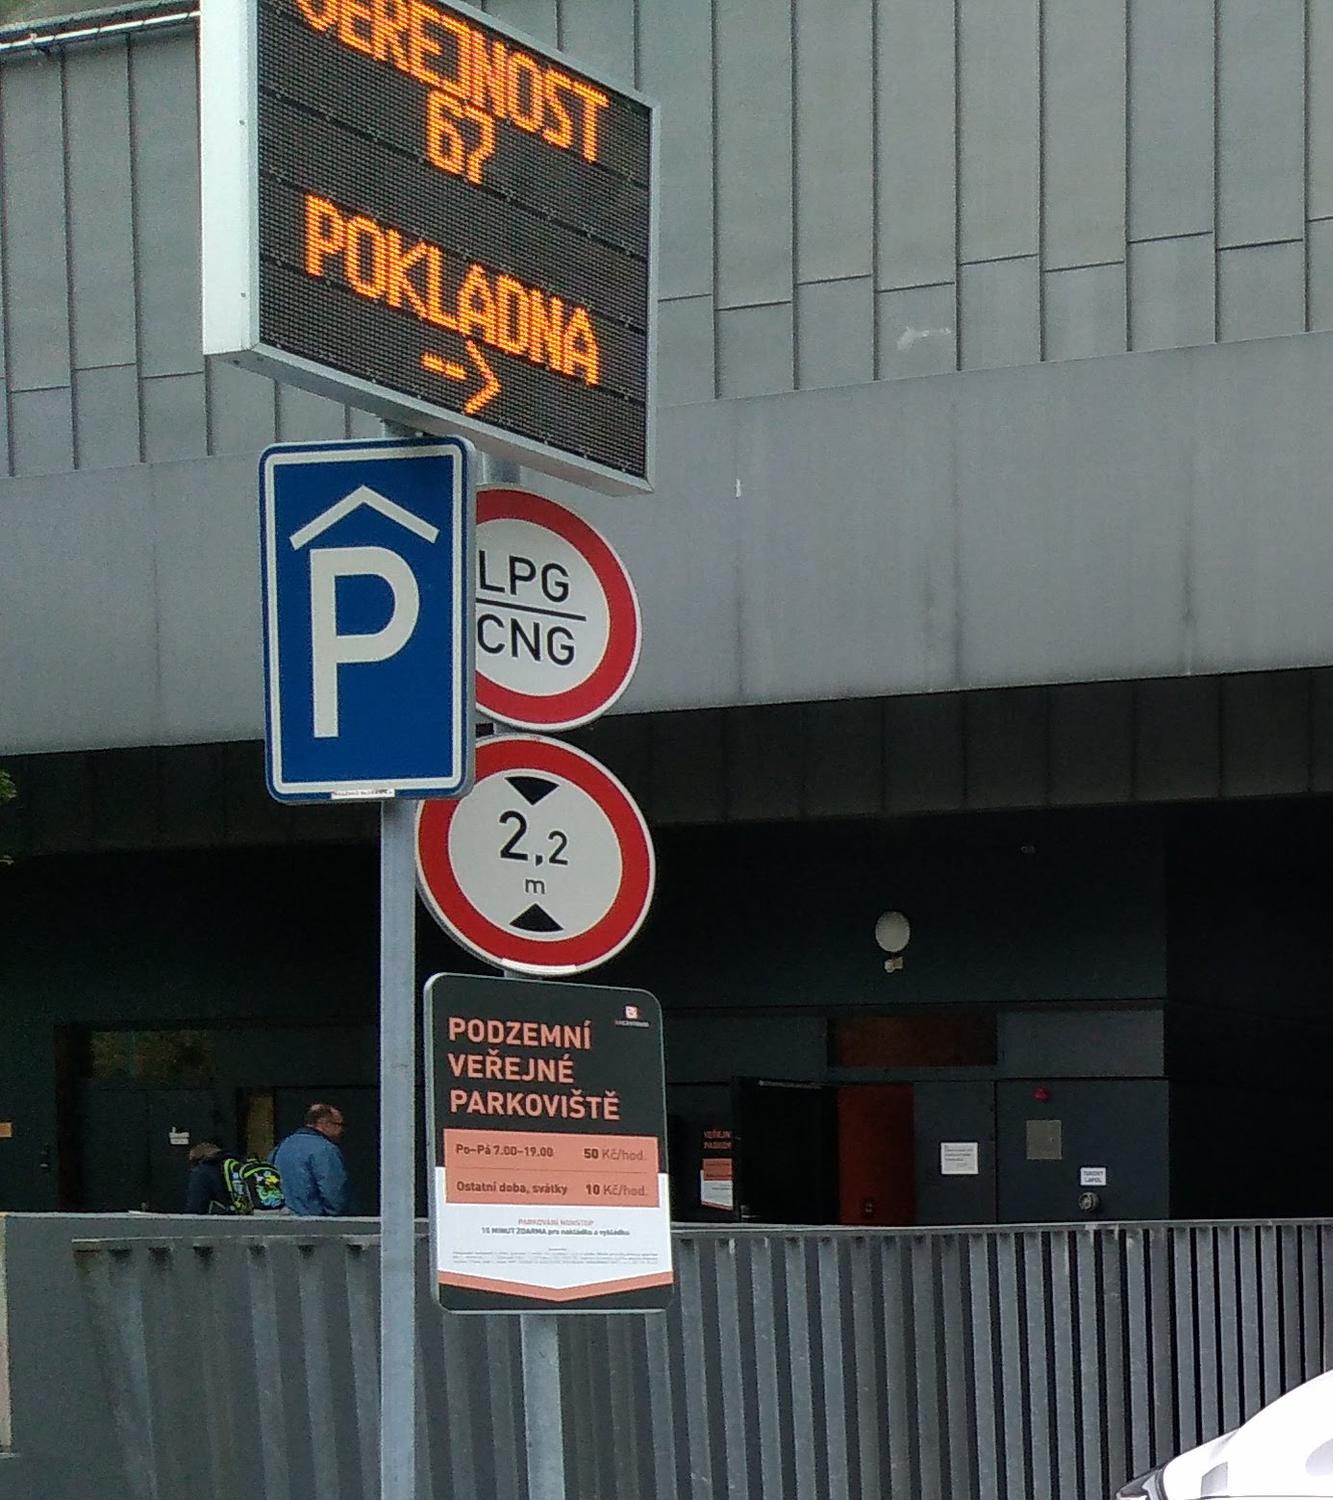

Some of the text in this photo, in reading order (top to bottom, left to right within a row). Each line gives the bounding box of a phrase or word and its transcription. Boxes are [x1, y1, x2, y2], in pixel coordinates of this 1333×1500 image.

[305, 193, 599, 386] POKLADNA
[478, 550, 570, 602] LPG
[310, 546, 420, 738] P
[477, 613, 575, 665] CNG
[499, 810, 569, 867] 2,2
[525, 877, 547, 894] m
[449, 1016, 591, 1050] PODZEMNÍ
[449, 1049, 574, 1083] VEŘEJNÉ
[450, 1089, 620, 1121] PARKOVIŠTĚ
[584, 1148, 599, 1159] 50
[602, 1147, 647, 1161] Kč/hod.
[456, 1181, 648, 1197] Ostatní doba, svátky 10 Kč/hod.
